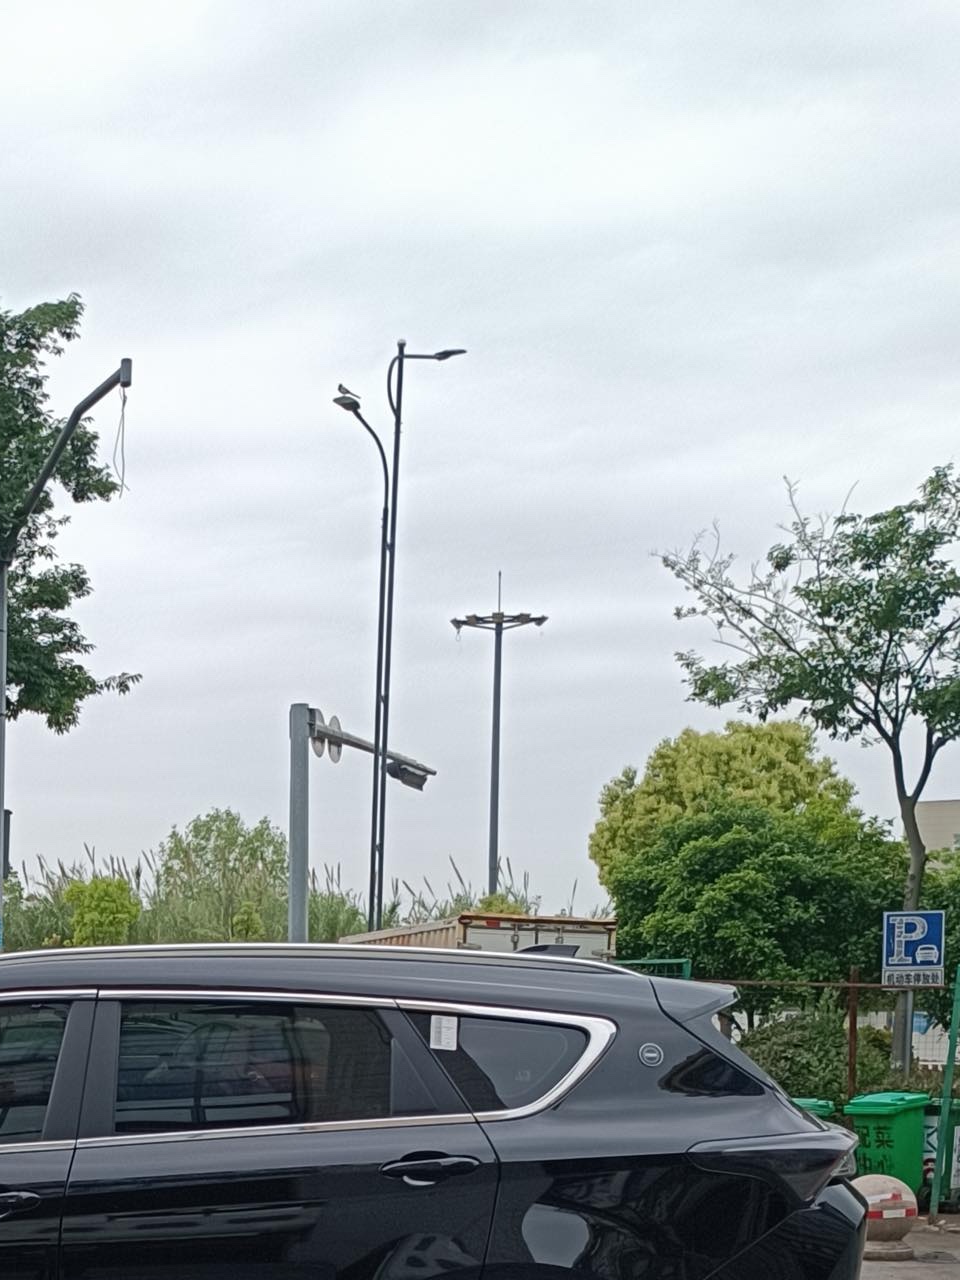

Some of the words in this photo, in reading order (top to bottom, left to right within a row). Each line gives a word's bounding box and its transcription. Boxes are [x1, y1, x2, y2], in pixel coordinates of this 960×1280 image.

[888, 916, 928, 964] P
[887, 973, 940, 985] 机动车停放处
